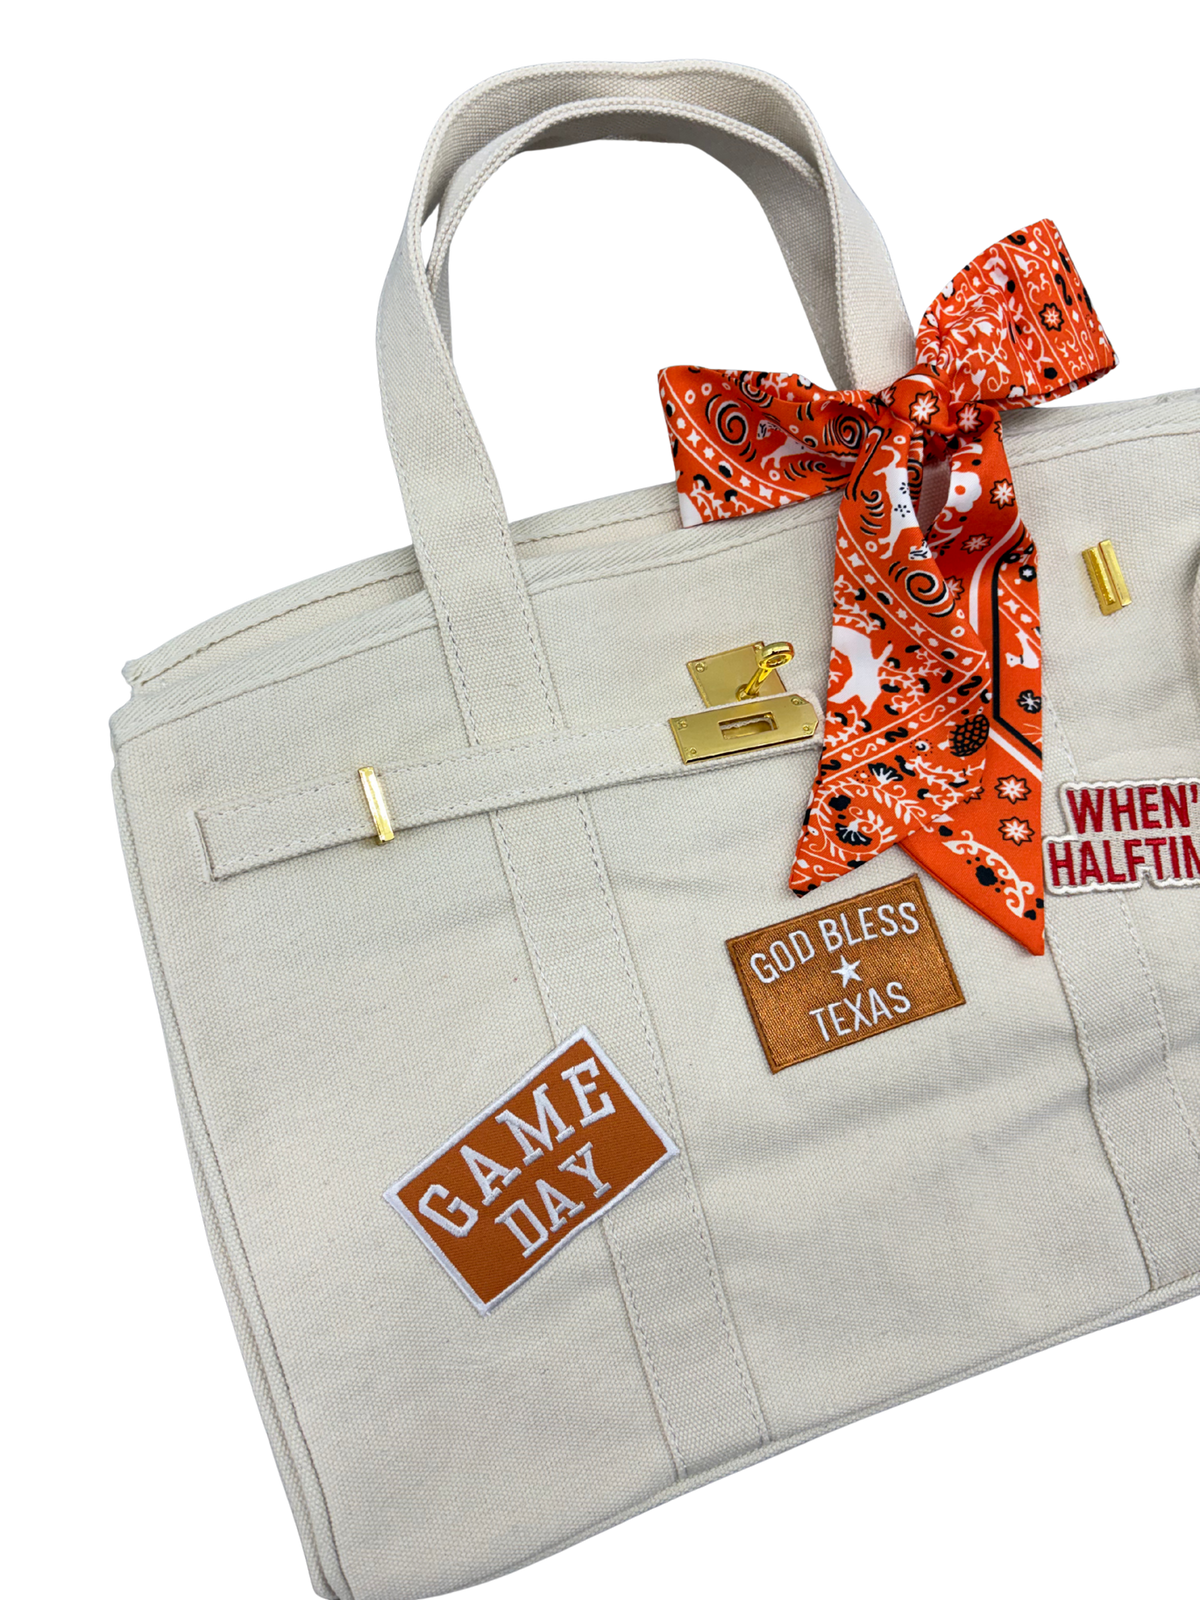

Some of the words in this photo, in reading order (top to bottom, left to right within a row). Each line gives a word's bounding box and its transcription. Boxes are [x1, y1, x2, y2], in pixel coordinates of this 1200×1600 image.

[750, 929, 815, 984] GOD
[818, 902, 920, 953] BLESS
[809, 981, 911, 1042] TEXAS
[418, 1057, 616, 1238] GAME
[494, 1141, 612, 1258] DAY
